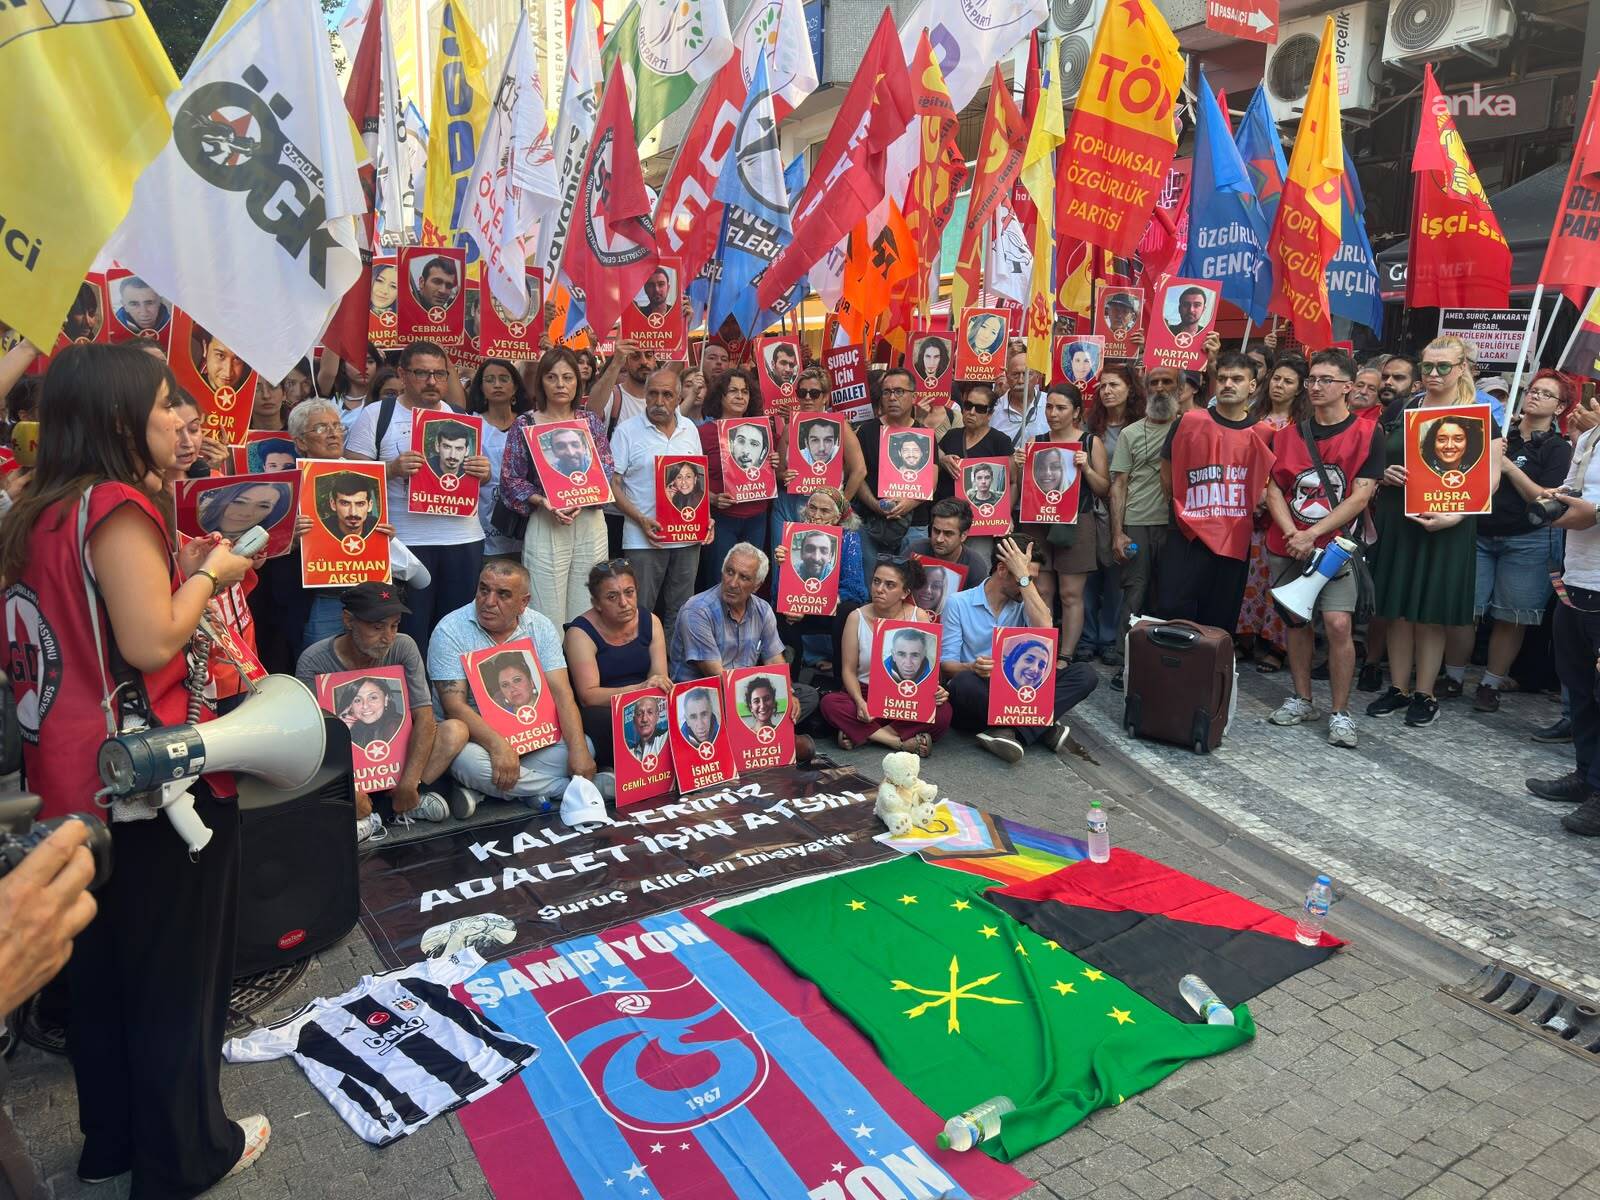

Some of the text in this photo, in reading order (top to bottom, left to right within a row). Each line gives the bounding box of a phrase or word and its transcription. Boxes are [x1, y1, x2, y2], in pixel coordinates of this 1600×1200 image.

[1336, 10, 1351, 64] arçelik
[1072, 132, 1161, 179] TOPLUMSAL
[1067, 160, 1150, 208] ÖZGÜRLÜK
[1066, 199, 1124, 232] PARTİSİ
[1466, 312, 1490, 322] SURUÇ,
[368, 330, 398, 340] NURA
[411, 324, 451, 333] CEBRAİL
[630, 331, 673, 340] NARTAN
[493, 339, 531, 350] VEYSEL
[486, 347, 537, 360] ÖZDEMİR
[827, 349, 860, 371] SURUÇ
[1153, 348, 1199, 360] NARTAN
[1480, 351, 1508, 360] LACAK!
[965, 365, 995, 374] NURAY
[1161, 358, 1189, 369] KILIÇ
[834, 367, 854, 388] İÇİN
[964, 373, 995, 381] KOÇAN
[832, 385, 865, 406] ADALET
[735, 482, 765, 491] VATAN
[803, 477, 827, 485] MERT
[889, 483, 922, 491] MURAT
[557, 485, 601, 499] ÇAĞDAŞ
[736, 490, 767, 500] BUDAK
[1184, 482, 1246, 511] ADALET
[1423, 489, 1471, 503] BÜŞRA
[412, 491, 475, 507] SÜLEYMAN
[565, 494, 599, 506] AYDIN
[427, 504, 459, 515] AKSU
[1040, 506, 1057, 514] ECE
[1429, 501, 1466, 512] METE
[667, 524, 701, 533] DUYGU
[671, 532, 698, 541] TUNA
[307, 558, 386, 573] SÜLEYMAN
[328, 572, 369, 585] AKSU
[786, 594, 828, 607] ÇAĞDAŞ
[789, 604, 823, 614] AYDIN
[884, 696, 919, 710] İSMET
[882, 708, 918, 720] ŞEKER
[1004, 705, 1038, 715] NAZLI
[994, 713, 1046, 725] AKYÜREK
[516, 735, 557, 755] OYRAZ
[742, 745, 782, 759] H.EZGİ
[691, 760, 721, 777] İSMET
[745, 756, 780, 769] SADET
[354, 776, 398, 793] TUNA
[622, 770, 671, 792] CEMİL YILDIZ
[694, 771, 724, 789] ŞEKER
[419, 790, 868, 913] ADALET İÇİN ATSIN
[537, 889, 629, 921] Suruç
[639, 860, 735, 894] Aileleri
[464, 919, 711, 1009] ŞAMPİYON
[363, 1015, 425, 1050] beko
[685, 1087, 722, 1111] 1967
